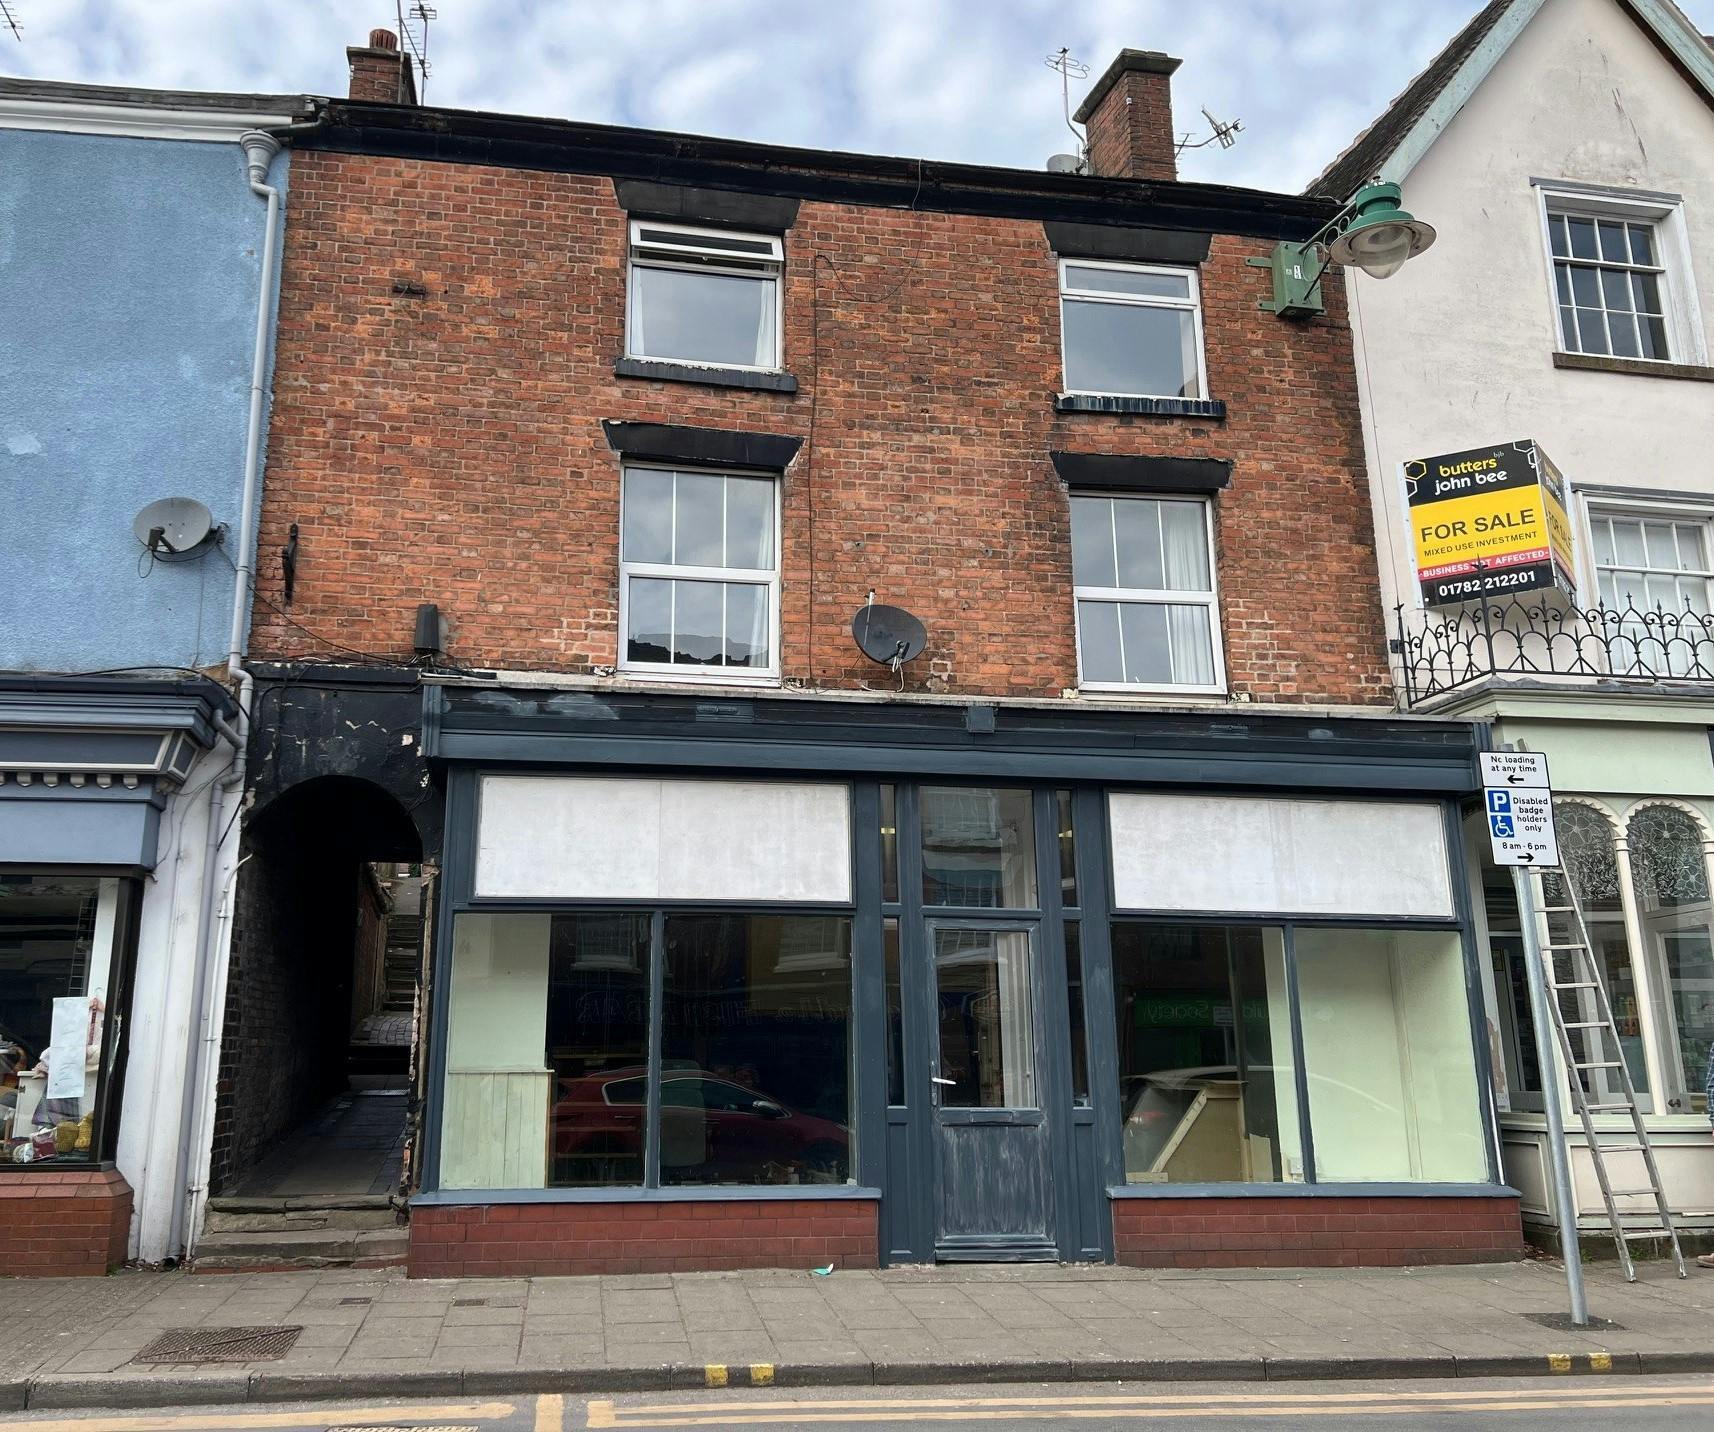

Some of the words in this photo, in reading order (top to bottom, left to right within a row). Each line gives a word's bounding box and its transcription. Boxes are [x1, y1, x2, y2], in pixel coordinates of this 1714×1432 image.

[1439, 457, 1498, 477] butters
[1434, 477, 1472, 496] john
[1475, 469, 1508, 485] bee
[1421, 521, 1468, 543] FOR
[1474, 508, 1536, 533] SALE
[1423, 544, 1454, 557] MIXED
[1454, 541, 1475, 552] USE
[1476, 531, 1538, 548] INVESTMENT
[1438, 581, 1482, 597] 01782
[1485, 570, 1536, 589] 212201
[1505, 756, 1535, 765] loading
[1492, 793, 1507, 811] P
[1513, 797, 1548, 805] Disabled
[1517, 815, 1547, 823] holders
[1519, 807, 1544, 815] badge
[1502, 842, 1508, 850] 8
[1528, 842, 1533, 850] 6
